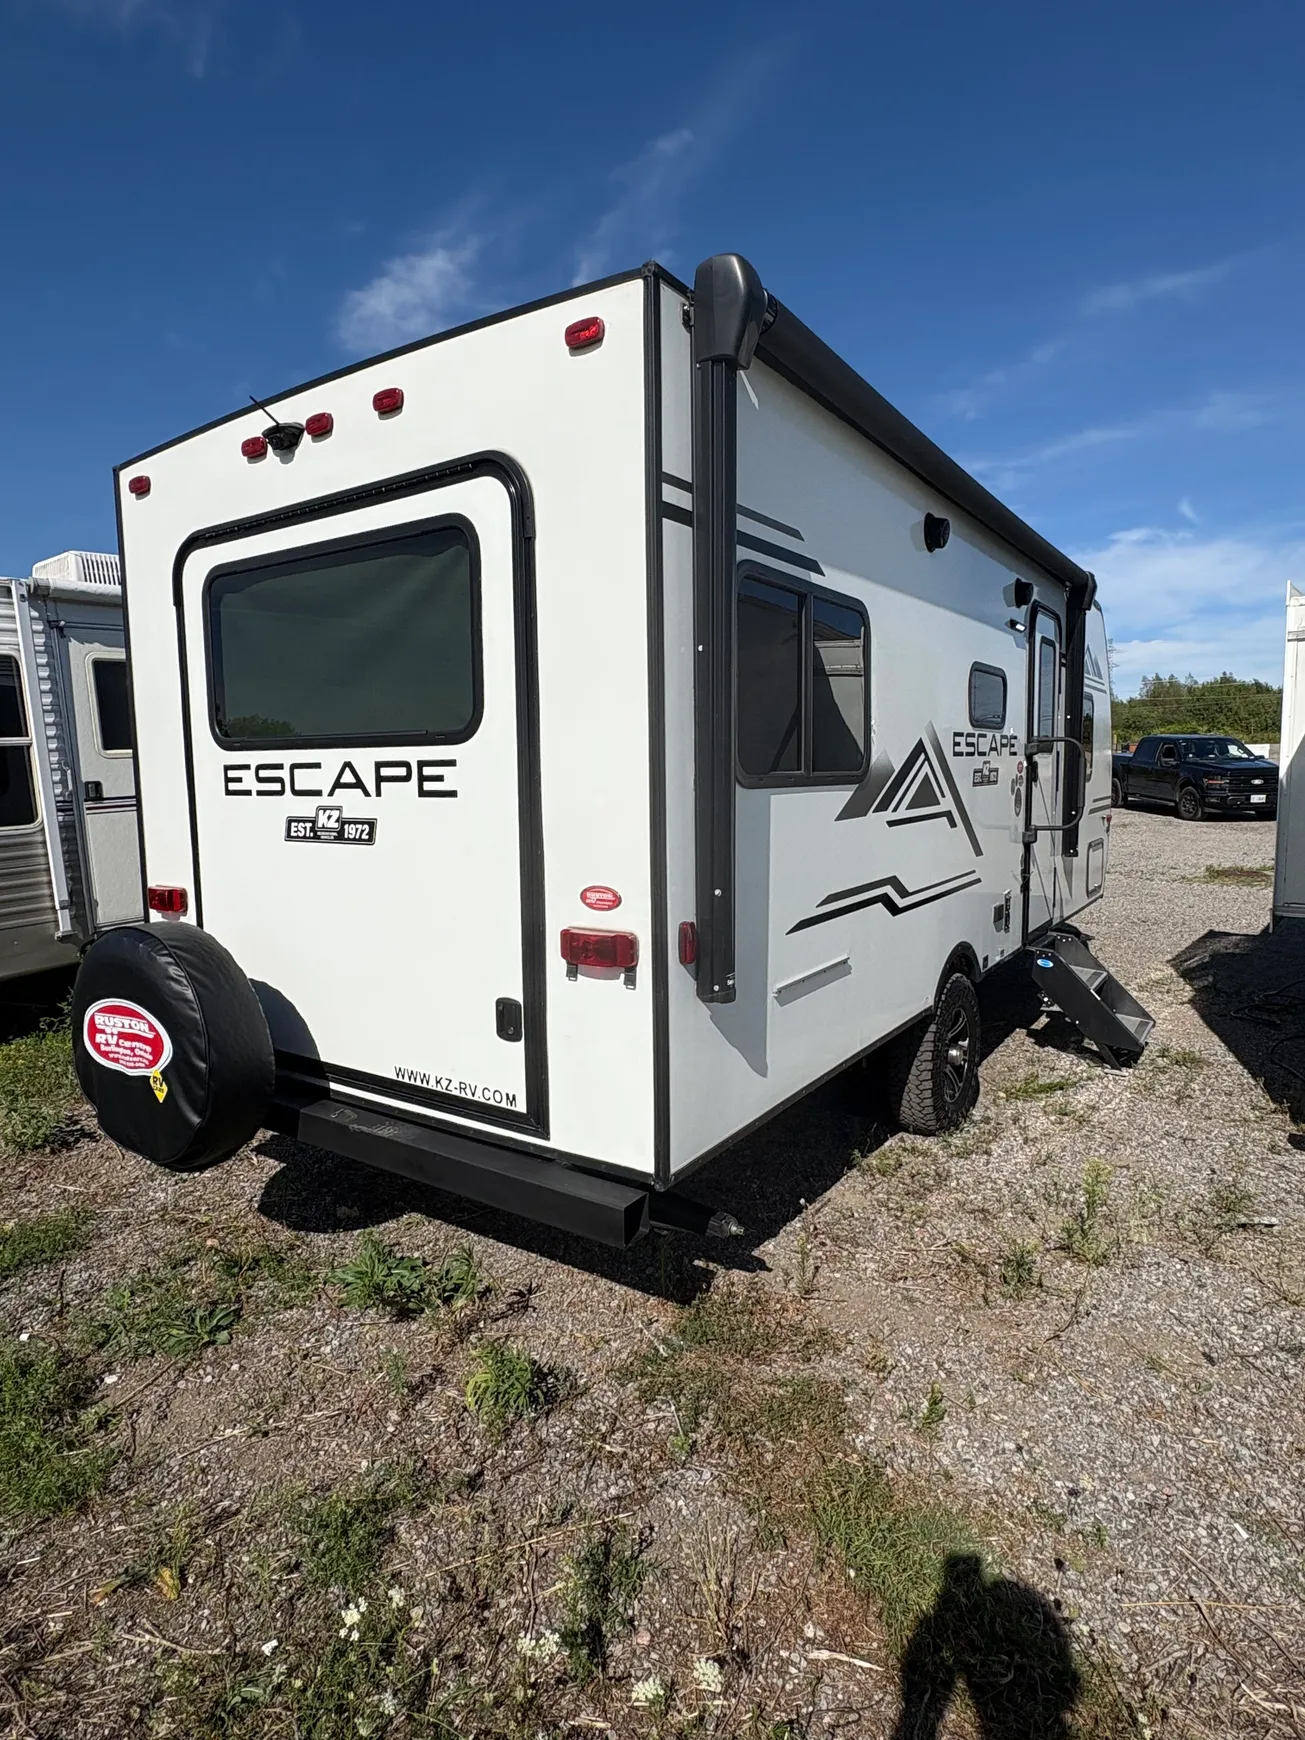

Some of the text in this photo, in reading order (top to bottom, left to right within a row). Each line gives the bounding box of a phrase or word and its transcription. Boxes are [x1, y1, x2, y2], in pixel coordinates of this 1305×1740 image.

[953, 731, 1017, 757] ESCAPE
[223, 759, 458, 798] ESCAPE
[317, 809, 340, 828] KZ
[290, 823, 369, 839] EST. 1972
[94, 1015, 149, 1032] RUSTON
[95, 1033, 118, 1044] RV
[152, 1076, 163, 1087] RV
[394, 1066, 517, 1108] WWW.KZ-RV.COM
